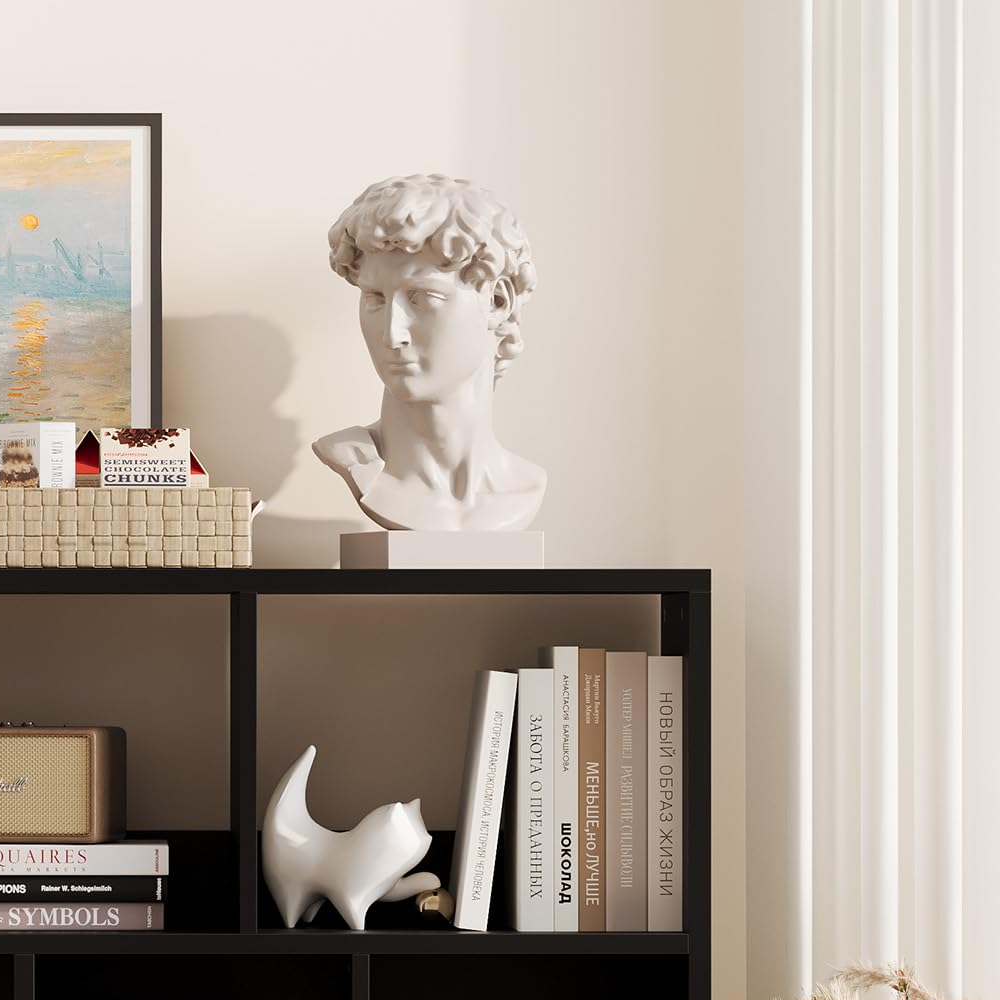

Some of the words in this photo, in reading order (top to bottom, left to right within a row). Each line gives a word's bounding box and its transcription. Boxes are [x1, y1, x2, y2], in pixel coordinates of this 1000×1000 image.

[0, 438, 24, 449] BROWNIE
[26, 439, 36, 448] MIX
[52, 440, 63, 456] MIX
[51, 460, 64, 487] ROWNIE
[104, 475, 186, 483] CHUNKS
[491, 710, 504, 749] ИСТОРИЯ
[530, 714, 542, 774] ЗАБОТА
[660, 692, 676, 759] НОВЫЙ
[530, 780, 542, 792] О
[621, 765, 632, 822] РАЗВИТИЕ
[660, 765, 673, 822] ОБРАЗ
[477, 820, 489, 858] ИСТОРИЯ
[528, 797, 542, 899] ПРЕДАННЫХ
[471, 860, 484, 901] ЧЕЛОВЕКА
[559, 823, 571, 904] ШОКОЛАД
[585, 853, 599, 906] ЛУЧШЕ
[660, 829, 673, 896] ЖИЗНИ
[8, 907, 120, 926] SYMBOLS
